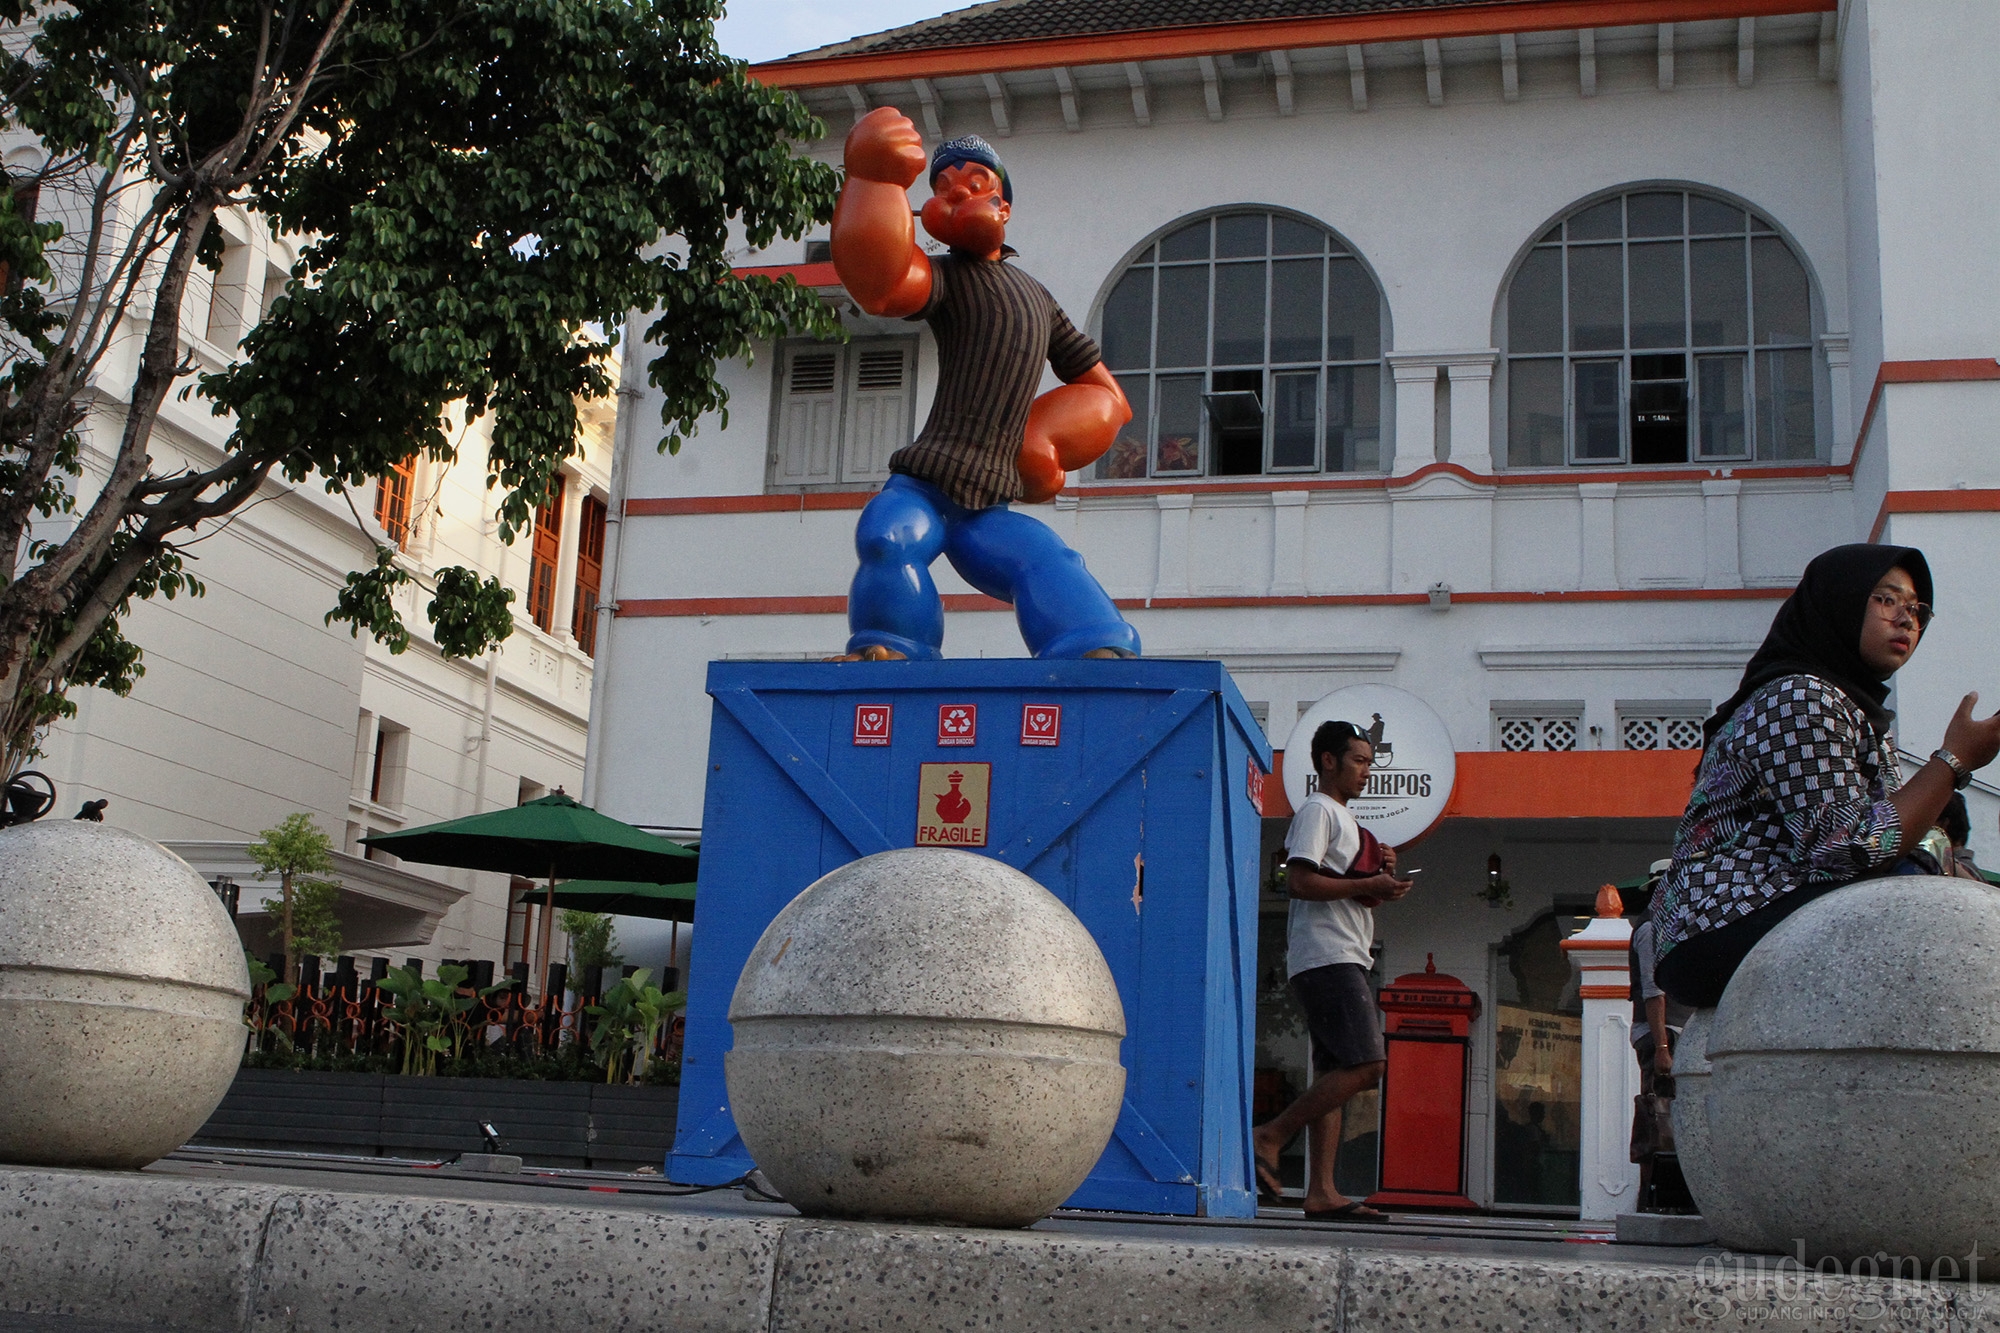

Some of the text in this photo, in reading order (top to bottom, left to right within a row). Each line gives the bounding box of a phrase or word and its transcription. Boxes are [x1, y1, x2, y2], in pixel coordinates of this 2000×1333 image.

[1305, 774, 1432, 797] KAKPOS
[1386, 806, 1410, 818] JOGJA
[919, 826, 982, 843] FRAGILE
